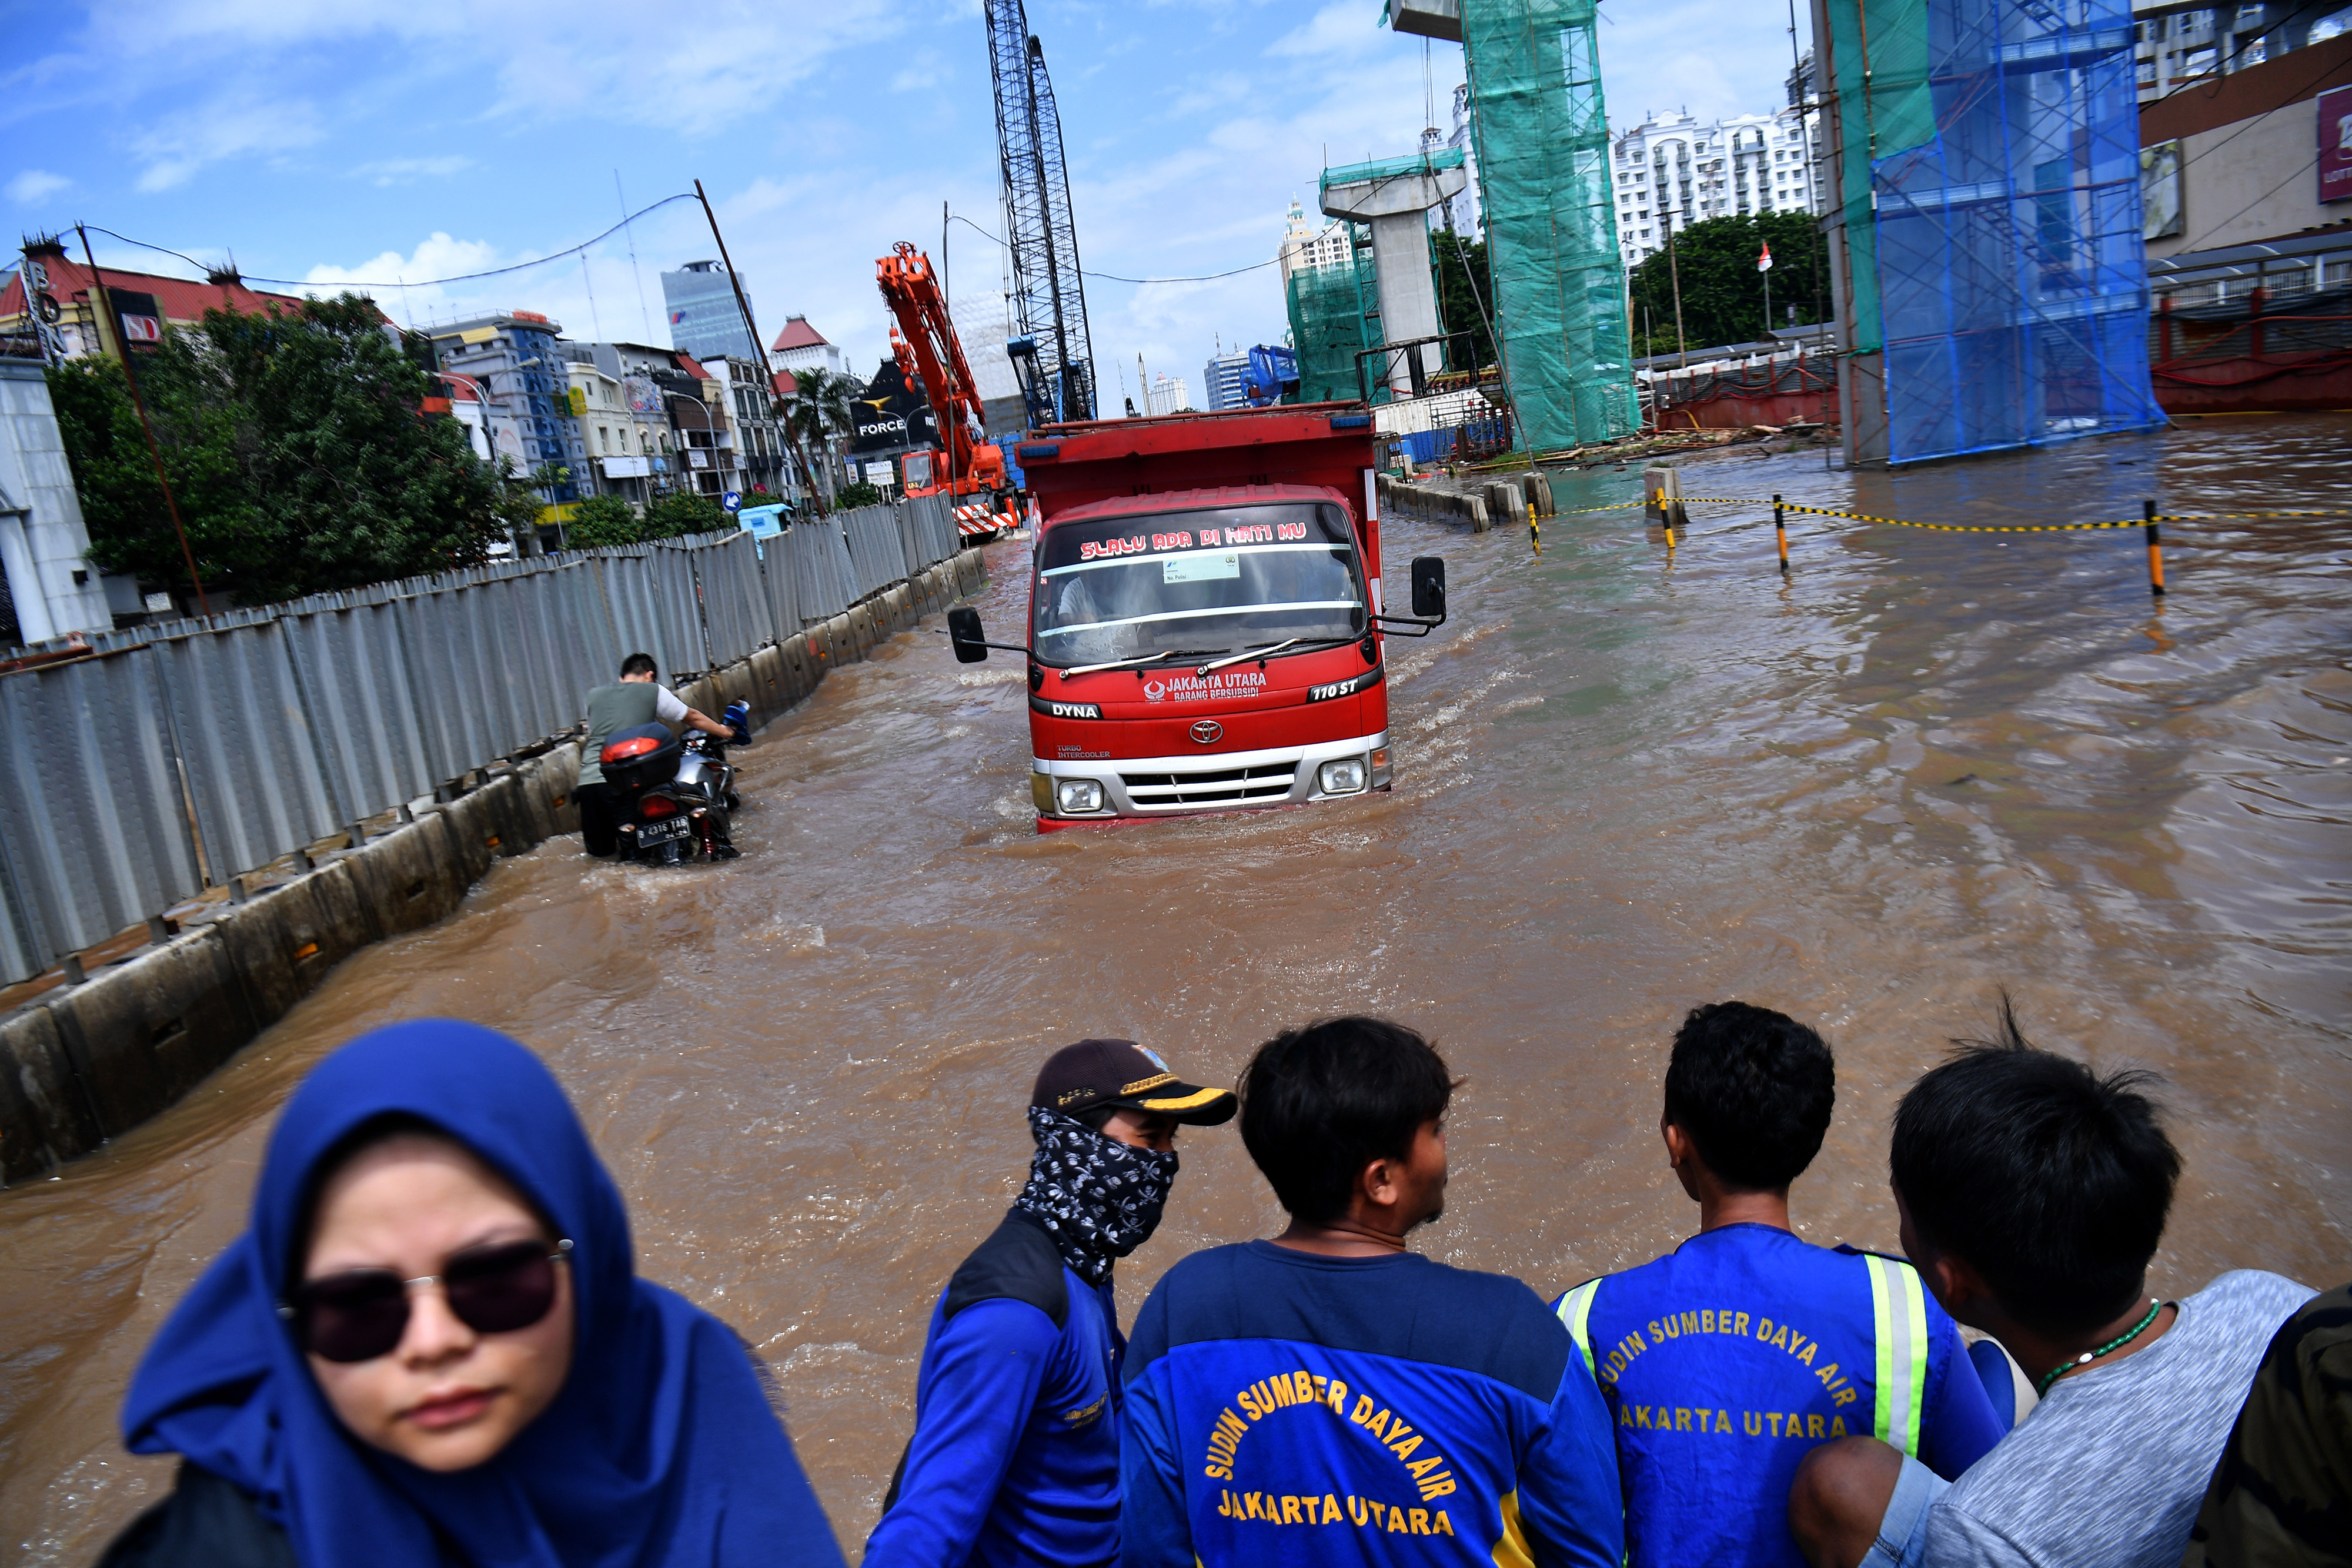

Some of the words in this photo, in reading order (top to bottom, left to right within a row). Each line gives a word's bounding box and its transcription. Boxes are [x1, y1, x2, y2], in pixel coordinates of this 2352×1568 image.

[859, 419, 906, 436] FORCE
[1081, 536, 1146, 560] SLALU
[1152, 531, 1193, 550] ADA
[1200, 529, 1221, 546] DI
[1225, 524, 1273, 543] HATI
[1277, 523, 1307, 540] MU
[1167, 674, 1222, 692] JAKARTA
[1225, 673, 1267, 687] UTARA
[1314, 686, 1337, 700] 110
[1339, 678, 1358, 695] ST
[1174, 690, 1208, 702] BARANG
[1210, 687, 1258, 699] BERSUBSIDI
[1053, 704, 1098, 718] DYNA
[638, 830, 645, 839] B
[1648, 1310, 1749, 1343] SUMBER
[1756, 1317, 1818, 1366] DAYA
[1815, 1363, 1857, 1408] AIR
[1621, 1405, 1733, 1434] AKARTA
[1744, 1411, 1847, 1438] UTARA
[1205, 1407, 1249, 1480] SUDIN
[1238, 1370, 1348, 1415] SUMBER
[1350, 1394, 1424, 1461] DAYA
[1405, 1456, 1456, 1502] AIR
[1218, 1489, 1343, 1524] JAKARTA
[1348, 1495, 1455, 1536] UTARA
